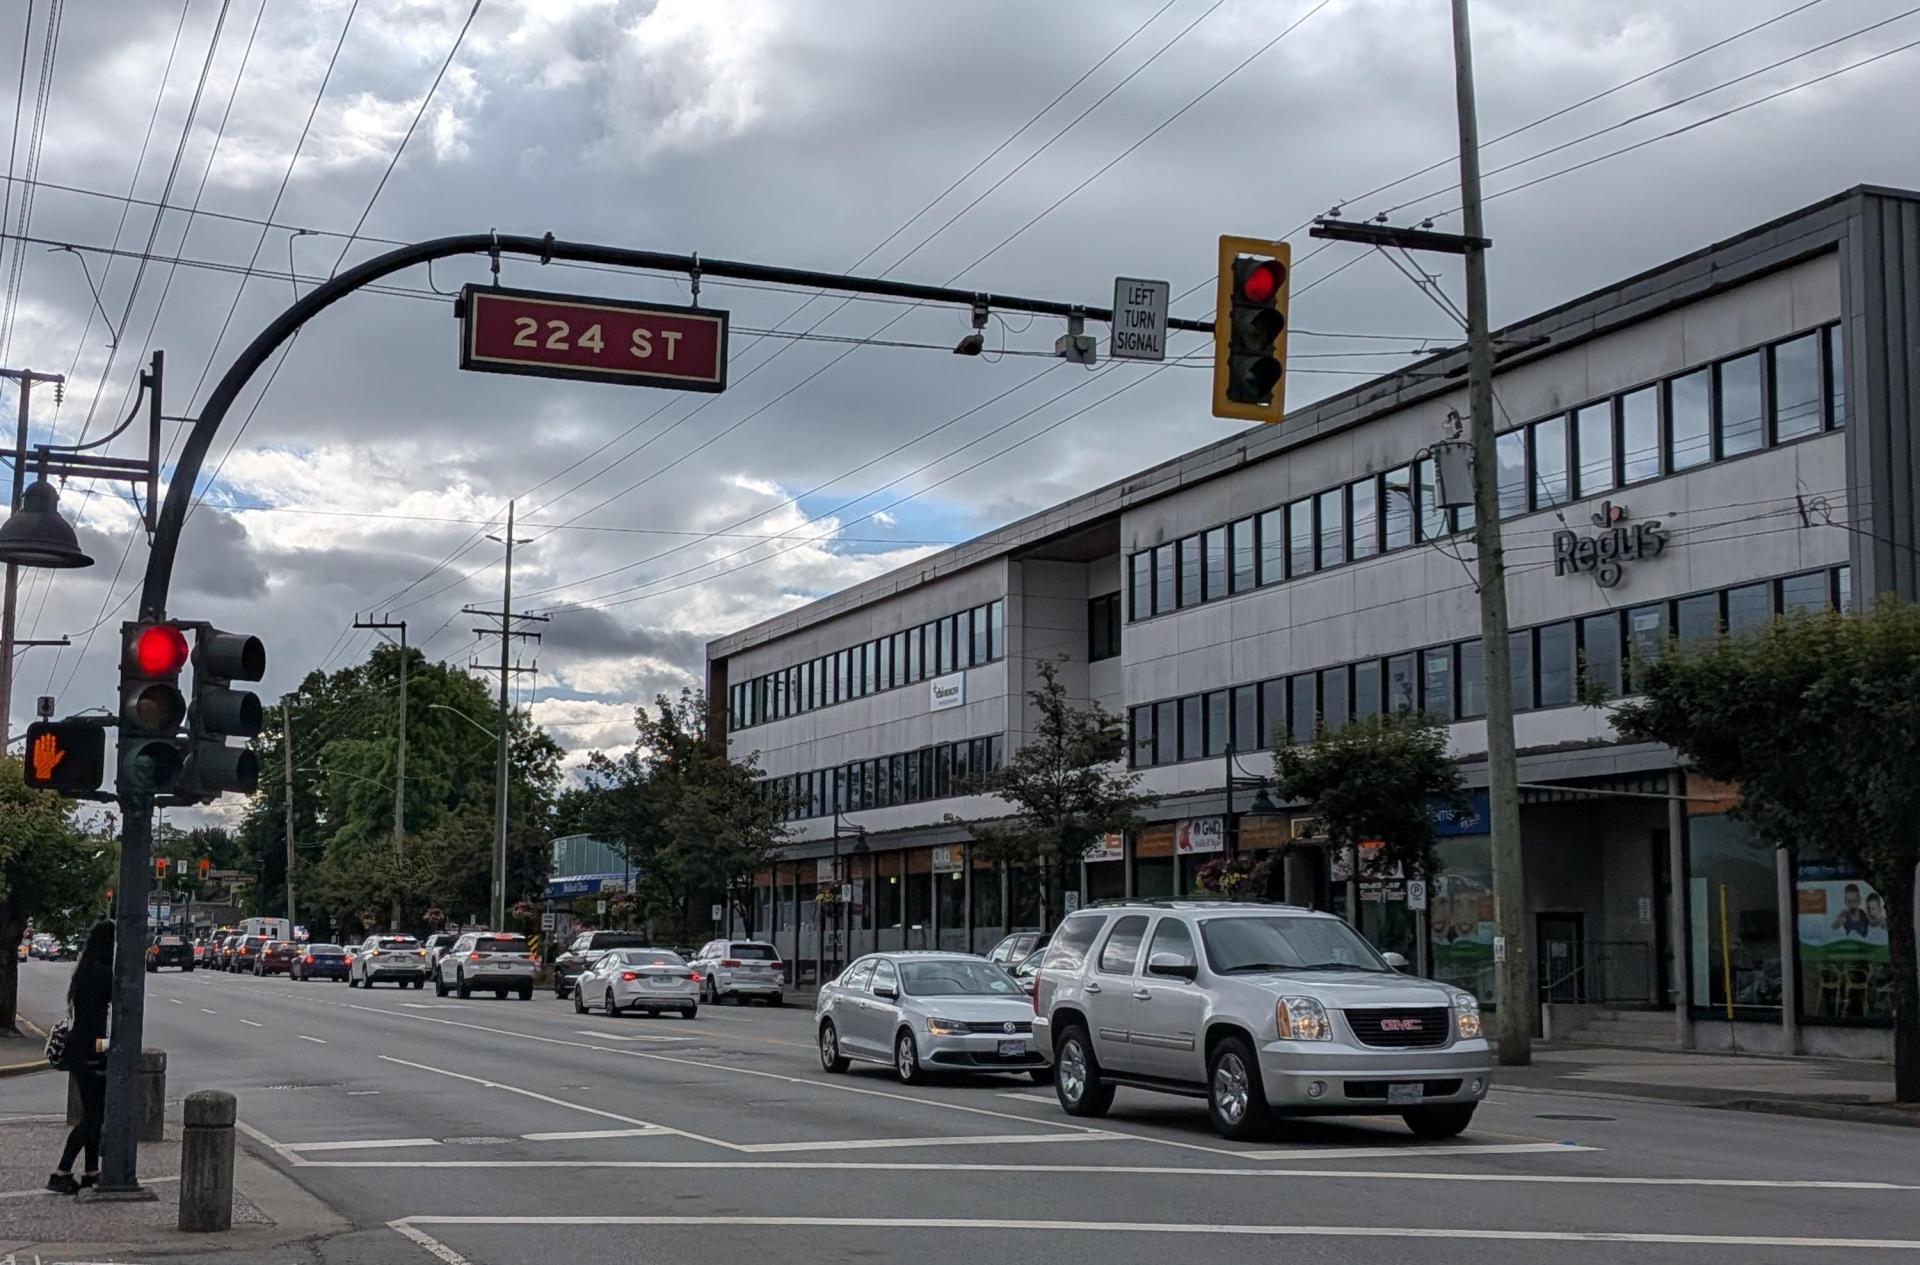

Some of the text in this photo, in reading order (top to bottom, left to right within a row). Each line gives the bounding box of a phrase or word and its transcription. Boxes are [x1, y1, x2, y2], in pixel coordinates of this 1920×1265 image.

[1128, 286, 1155, 306] LEFT
[1124, 309, 1156, 329] TURN
[513, 317, 683, 361] 224 ST
[1117, 331, 1159, 352] SIGNAL
[1552, 520, 1665, 588] Regus
[1381, 1019, 1423, 1031] GMC
